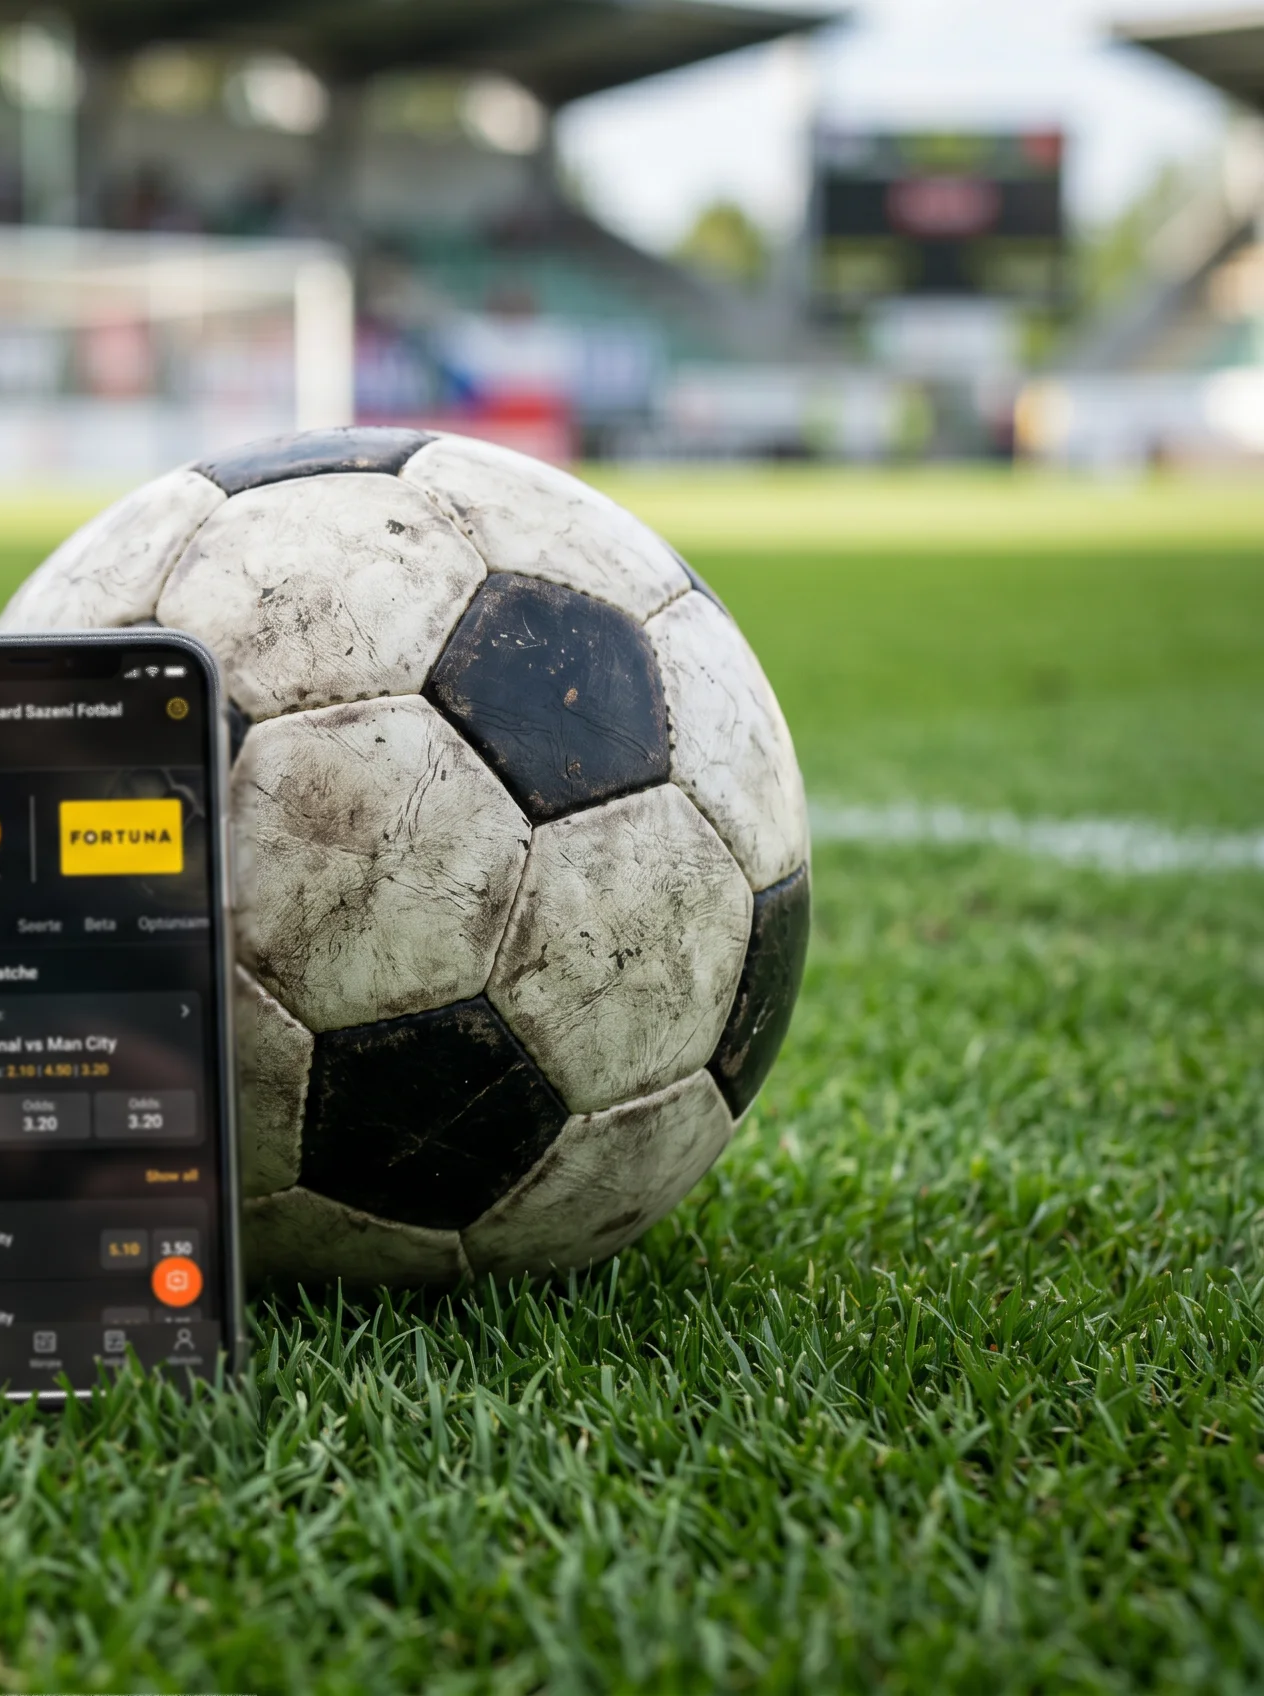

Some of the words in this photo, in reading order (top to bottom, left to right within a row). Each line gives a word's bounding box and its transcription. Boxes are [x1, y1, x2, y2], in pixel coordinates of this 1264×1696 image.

[78, 701, 123, 718] Fotbal
[70, 829, 172, 846] FORTUNA
[25, 1040, 43, 1053] vs
[47, 1037, 82, 1052] Man
[86, 1036, 117, 1054] City
[23, 1117, 58, 1132] 3.20
[128, 1114, 163, 1130] 3.20
[145, 1169, 179, 1183] Show
[161, 1242, 193, 1256] 3.50
